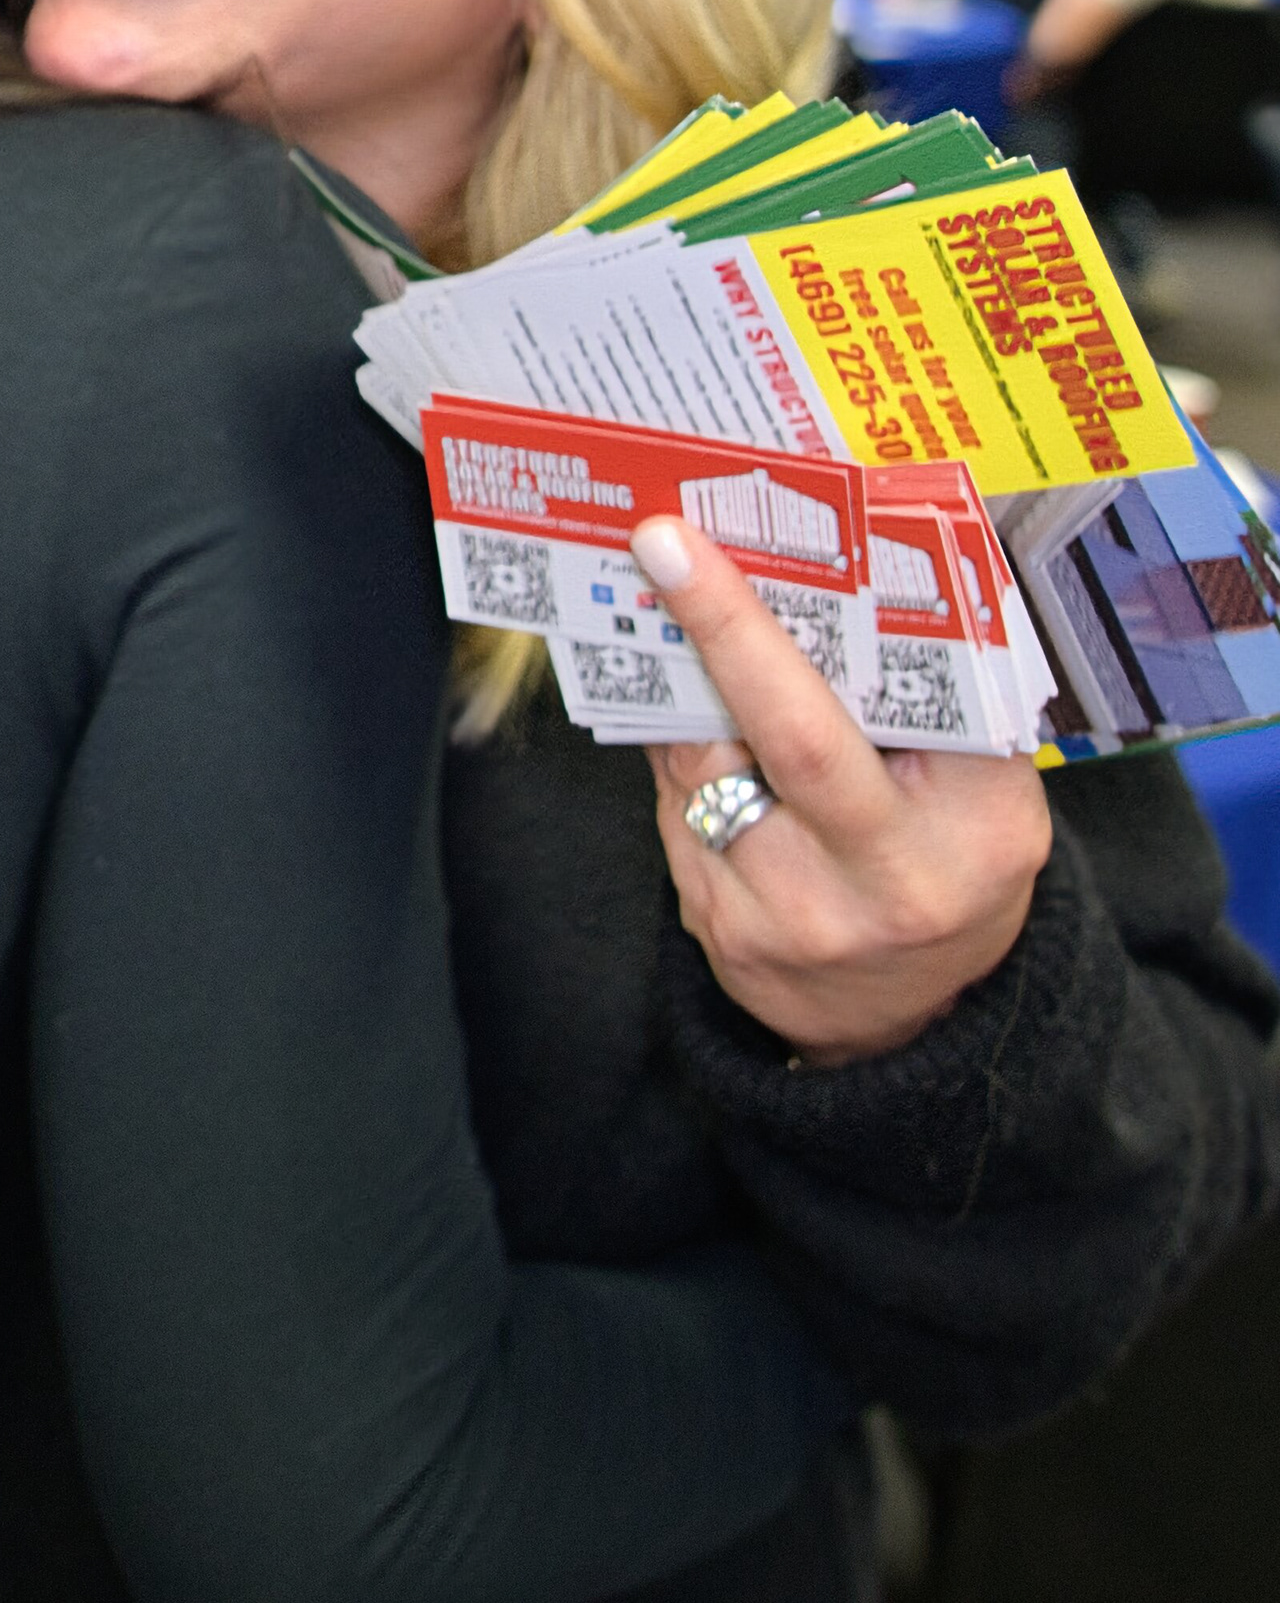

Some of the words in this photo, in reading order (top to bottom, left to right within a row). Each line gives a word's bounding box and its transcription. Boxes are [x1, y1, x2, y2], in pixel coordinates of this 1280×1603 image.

[712, 256, 764, 319] WHY
[838, 267, 879, 319] free
[878, 267, 923, 318] Call
[936, 213, 1034, 357] SYSTEMS
[975, 205, 1052, 309] SOLAR
[1015, 195, 1143, 411] STRUCTURED
[1024, 314, 1059, 339] &
[1037, 343, 1130, 474] ROOFING
